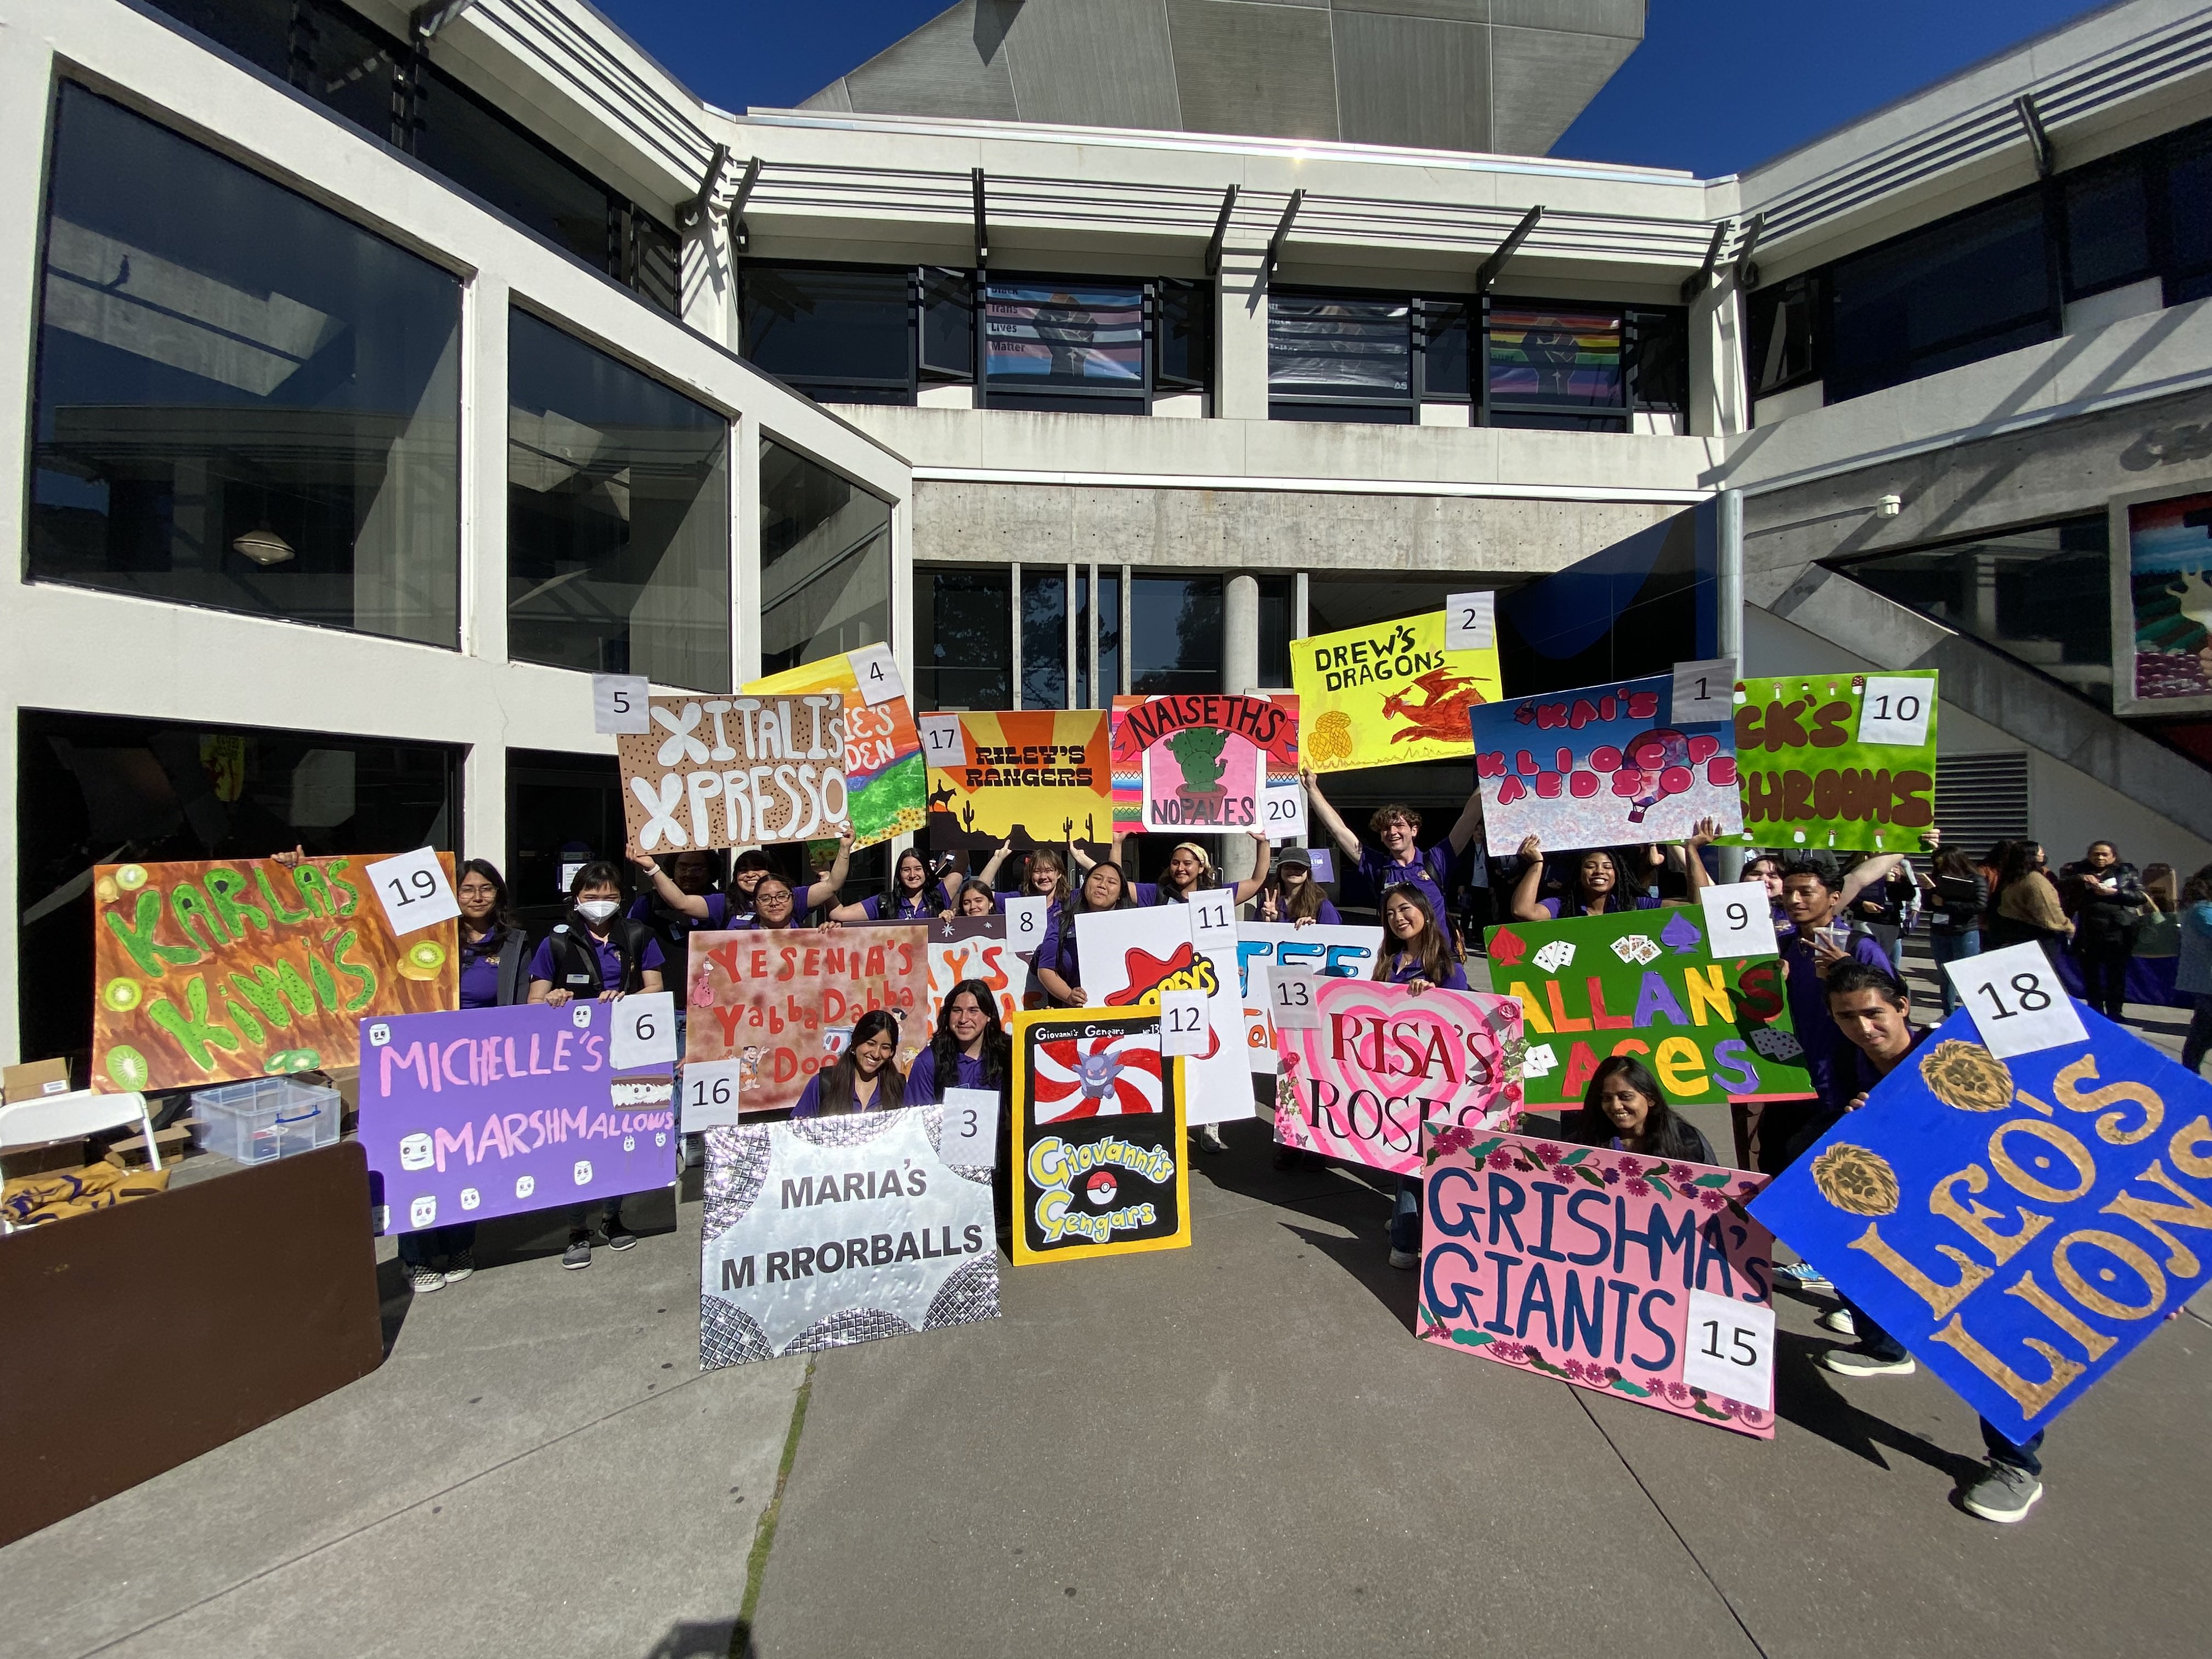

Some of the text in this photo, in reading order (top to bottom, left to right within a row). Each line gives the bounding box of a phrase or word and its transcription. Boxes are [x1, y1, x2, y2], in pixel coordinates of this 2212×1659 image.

[992, 303, 1018, 314] Trans
[991, 323, 1017, 332] Lives
[991, 342, 1025, 352] Matter
[1462, 608, 1476, 630] 2
[1316, 625, 1415, 672] DREW'S
[870, 662, 884, 681] 4
[1326, 650, 1445, 691] DRAGONS
[613, 692, 630, 713] 5
[1694, 677, 1711, 701] 1
[1536, 687, 1659, 730] KAI'S
[1873, 695, 1920, 721] 10
[650, 694, 844, 766] XITALI'S
[1127, 696, 1285, 751] NAISETH'S
[930, 729, 955, 750] 17
[975, 746, 1085, 765] RILEY'S
[966, 768, 1093, 788] RANGERS
[1153, 798, 1254, 827] NOPALES
[1268, 800, 1296, 821] 20
[388, 870, 436, 907] 19
[1020, 912, 1033, 932] 8
[1198, 906, 1228, 929] 11
[1726, 903, 1748, 930] 9
[708, 939, 912, 984] YESENIA'S
[1278, 983, 1308, 1005] 13
[1509, 960, 1784, 1034] ALLAN'S
[1978, 973, 2051, 1021] 18
[636, 1014, 654, 1040] 6
[1035, 1028, 1079, 1040] Giovanni's
[1085, 1025, 1124, 1039] Gengars
[1169, 1008, 1201, 1032] 12
[380, 1030, 603, 1097] MICHELLE'S
[1329, 1013, 1496, 1086] RISA'S
[692, 1079, 730, 1106] 16
[961, 1110, 977, 1138] 3
[435, 1106, 673, 1172] MARSHMALLOWS
[1029, 1136, 1173, 1189] Giovanni's
[781, 1159, 927, 1209] MARIA'S
[1847, 1053, 2165, 1321] LEO'S
[1036, 1188, 1156, 1243] Gengars
[1429, 1167, 1768, 1302] GRISHMA'S
[1424, 1243, 1675, 1371] GIANTS
[1701, 1320, 1756, 1366] 15
